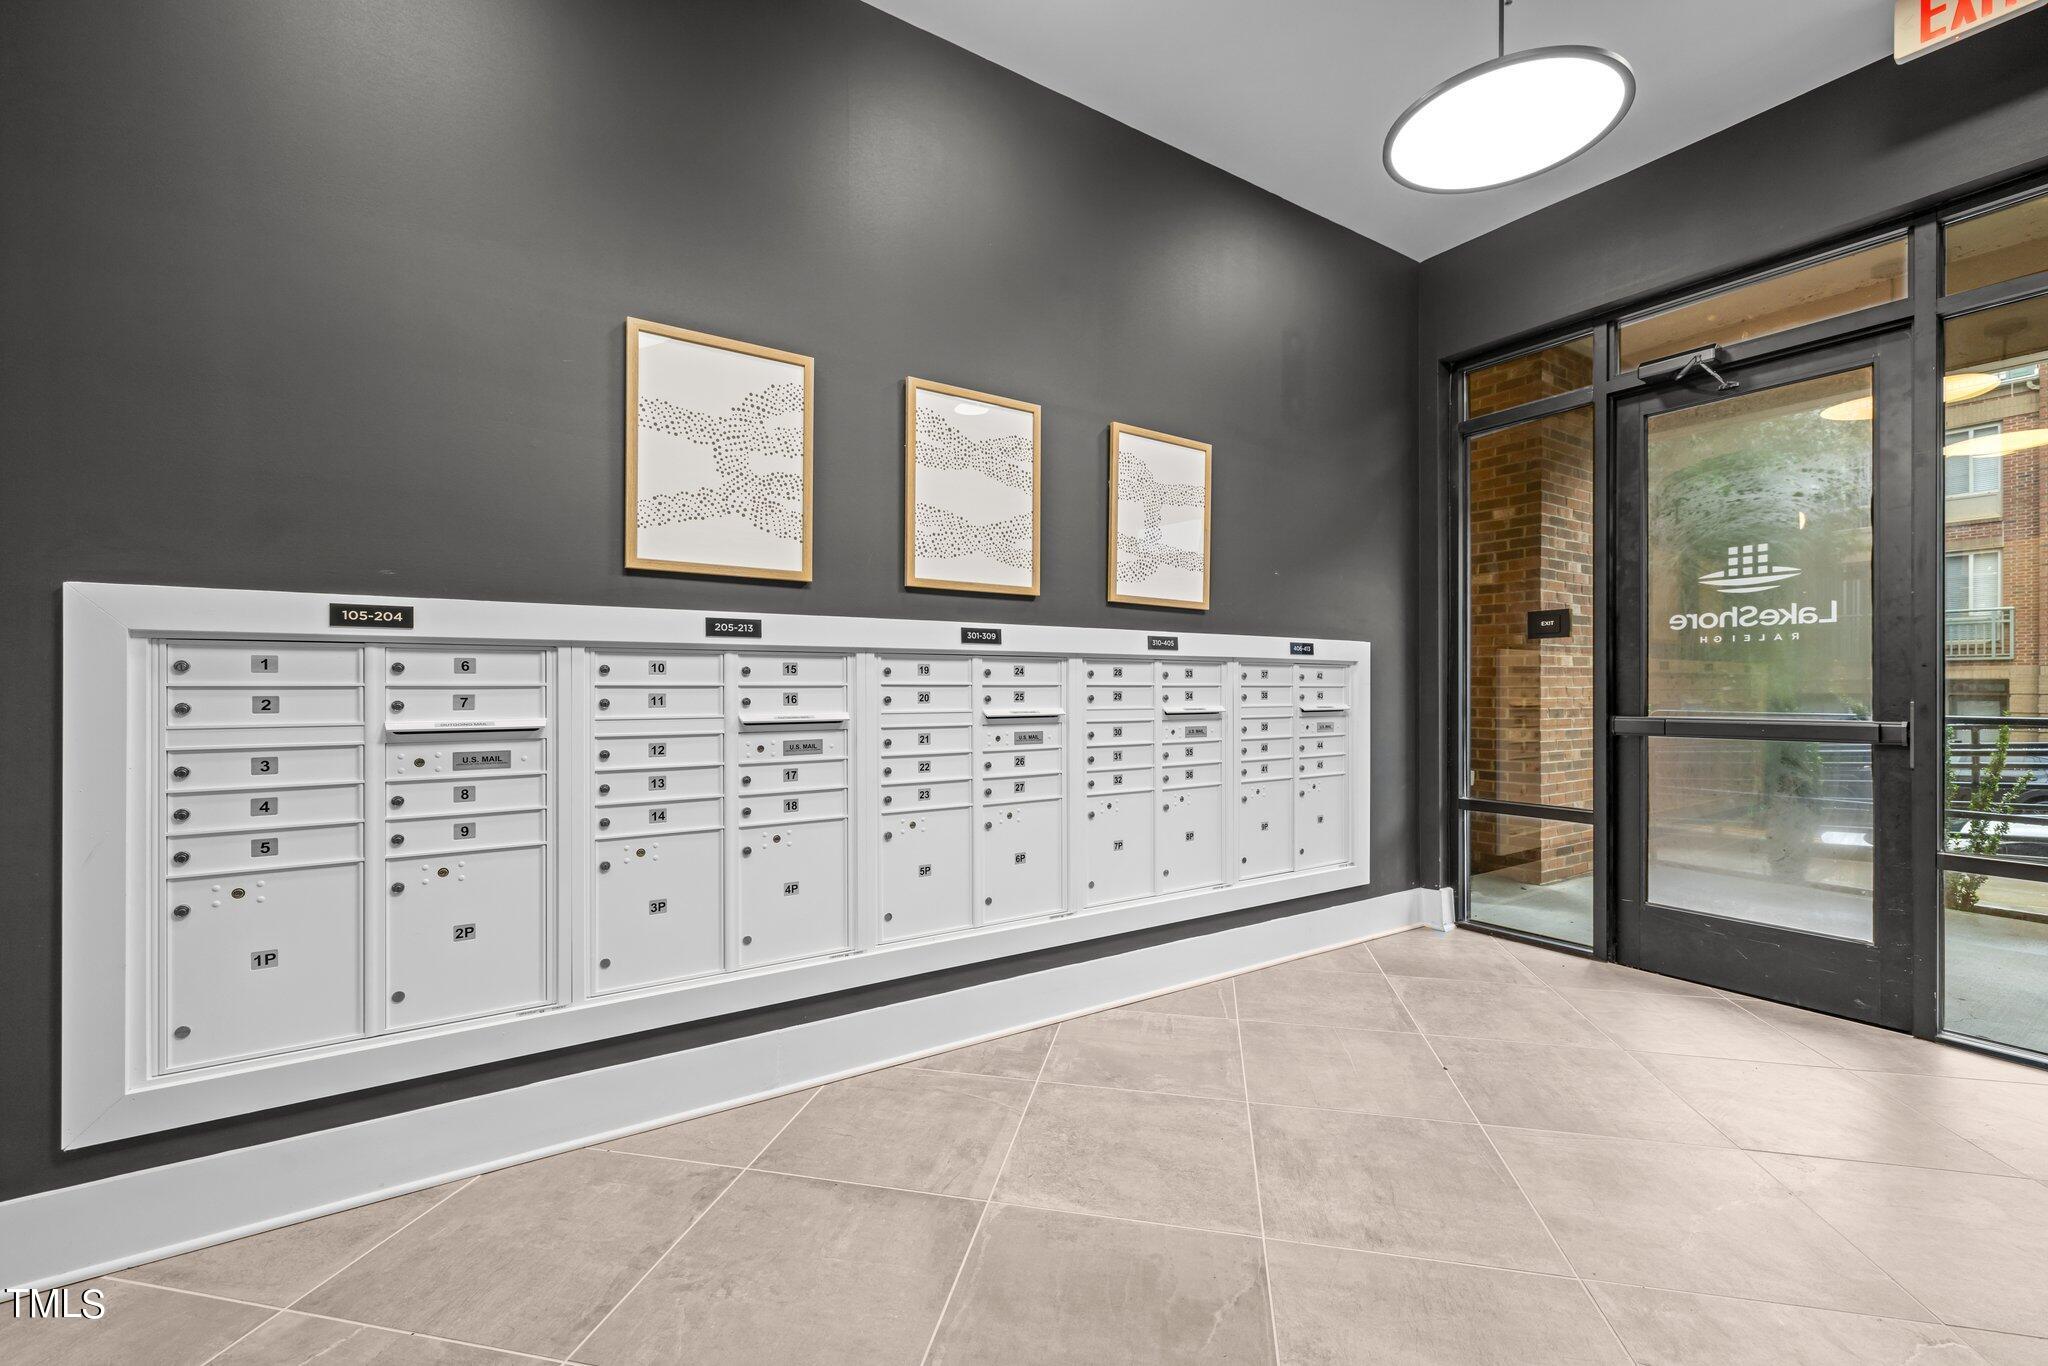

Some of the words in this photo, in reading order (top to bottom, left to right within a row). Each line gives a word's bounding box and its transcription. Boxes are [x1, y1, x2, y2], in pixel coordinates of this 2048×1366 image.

[341, 610, 403, 622] 105-204
[714, 622, 754, 633] 205-213
[967, 631, 997, 640] 301-309
[1152, 639, 1175, 647] 310-405
[260, 658, 268, 670] 1
[461, 660, 470, 672] 6
[651, 663, 665, 673] 10
[784, 664, 797, 674] 15
[919, 666, 930, 675] 19
[1014, 667, 1024, 676] 24
[650, 696, 663, 706] 11
[785, 694, 798, 704] 16
[919, 693, 930, 702] 20
[1014, 693, 1025, 701] 25
[260, 699, 271, 711] 2
[459, 697, 469, 708] 7
[919, 735, 929, 744] 21
[651, 745, 665, 755] 12
[788, 743, 802, 751] U.S.
[462, 756, 480, 764] U.S.
[481, 755, 503, 763] MAIL
[1015, 757, 1025, 766] 26
[260, 760, 270, 772] 3
[919, 762, 930, 772] 22
[785, 770, 797, 780] 17
[651, 778, 665, 789] 13
[1015, 783, 1025, 792] 27
[460, 788, 469, 800] 8
[919, 790, 930, 799] 23
[259, 801, 270, 813] 4
[785, 801, 798, 811] 18
[651, 811, 666, 821] 14
[460, 825, 469, 837] 9
[260, 841, 271, 854] 5
[1015, 854, 1026, 863] 6P
[919, 866, 931, 876] 5P
[784, 884, 799, 894] 4P
[650, 901, 666, 913] 3P
[455, 926, 475, 940] 2P
[253, 953, 277, 967] 1P
